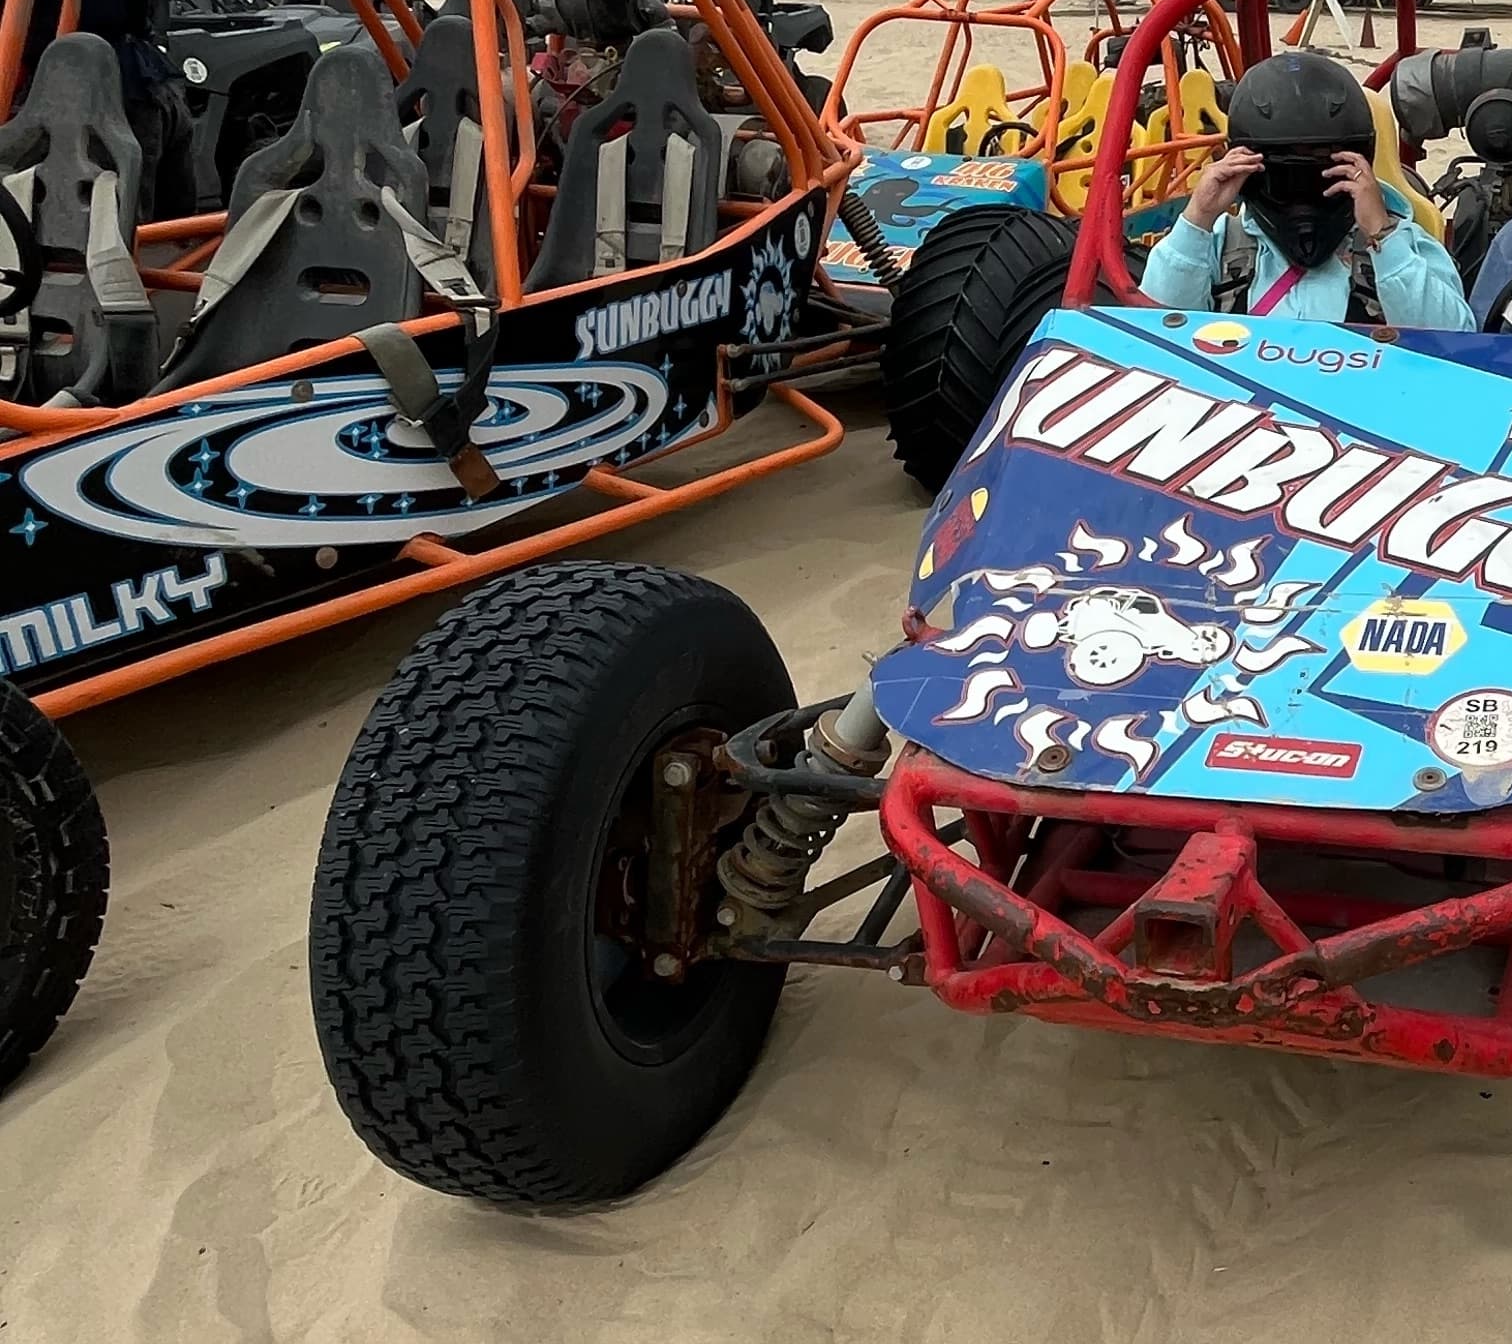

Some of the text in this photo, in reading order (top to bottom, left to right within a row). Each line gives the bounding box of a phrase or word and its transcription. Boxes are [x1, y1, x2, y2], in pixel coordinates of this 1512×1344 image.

[575, 268, 733, 360] SUNBUGGY
[1257, 340, 1383, 373] bugsi
[0, 552, 227, 677] MILKY
[1358, 618, 1447, 656] NADA
[1465, 699, 1498, 712] SB
[1456, 739, 1498, 754] 219
